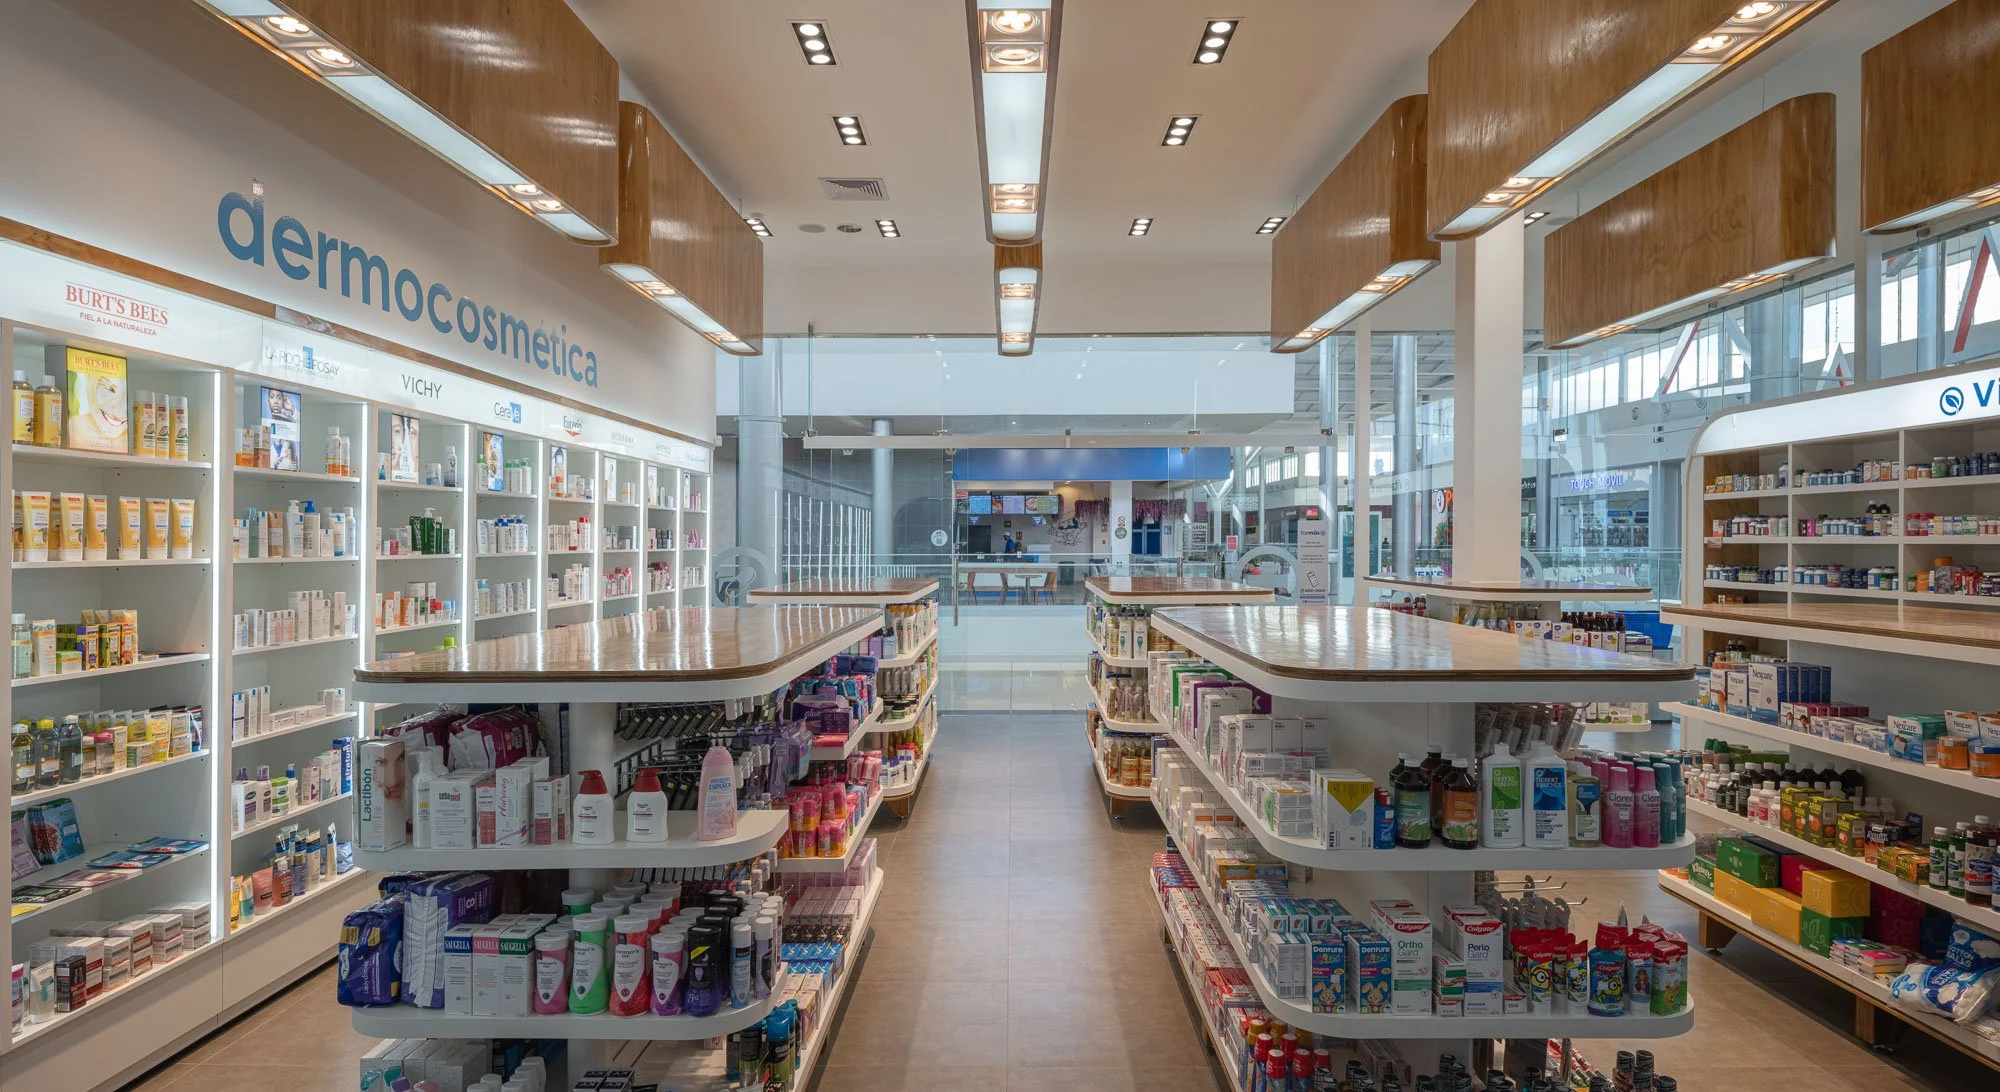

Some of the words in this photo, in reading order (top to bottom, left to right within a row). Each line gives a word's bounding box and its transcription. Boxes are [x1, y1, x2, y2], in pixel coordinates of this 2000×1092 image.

[217, 178, 598, 389] dermocosmética
[65, 284, 125, 314] BURT'S
[129, 302, 169, 325] BEES
[79, 312, 95, 322] FIEL
[103, 318, 113, 327] LA
[113, 320, 157, 336] NATURALEZA
[402, 374, 442, 400] VICHY
[1570, 478, 1594, 491] TOUCH
[1752, 669, 1773, 681] Nexcare
[1893, 719, 1917, 733] Nexcare
[1952, 719, 1973, 730] Nexcare
[438, 791, 461, 802] sebamed
[1691, 862, 1713, 880] Kleenex
[1397, 924, 1424, 932] Colgate
[1466, 925, 1494, 933] Colgate
[444, 940, 470, 950] SAUGELLA
[473, 940, 500, 950] SAUGELLA
[500, 942, 526, 952] SAUGELLA
[1397, 940, 1424, 949] Ortho
[1467, 943, 1490, 951] Perio
[1397, 948, 1419, 957] Gard
[1467, 950, 1488, 959] Gard
[1945, 950, 1972, 968] BALLS
